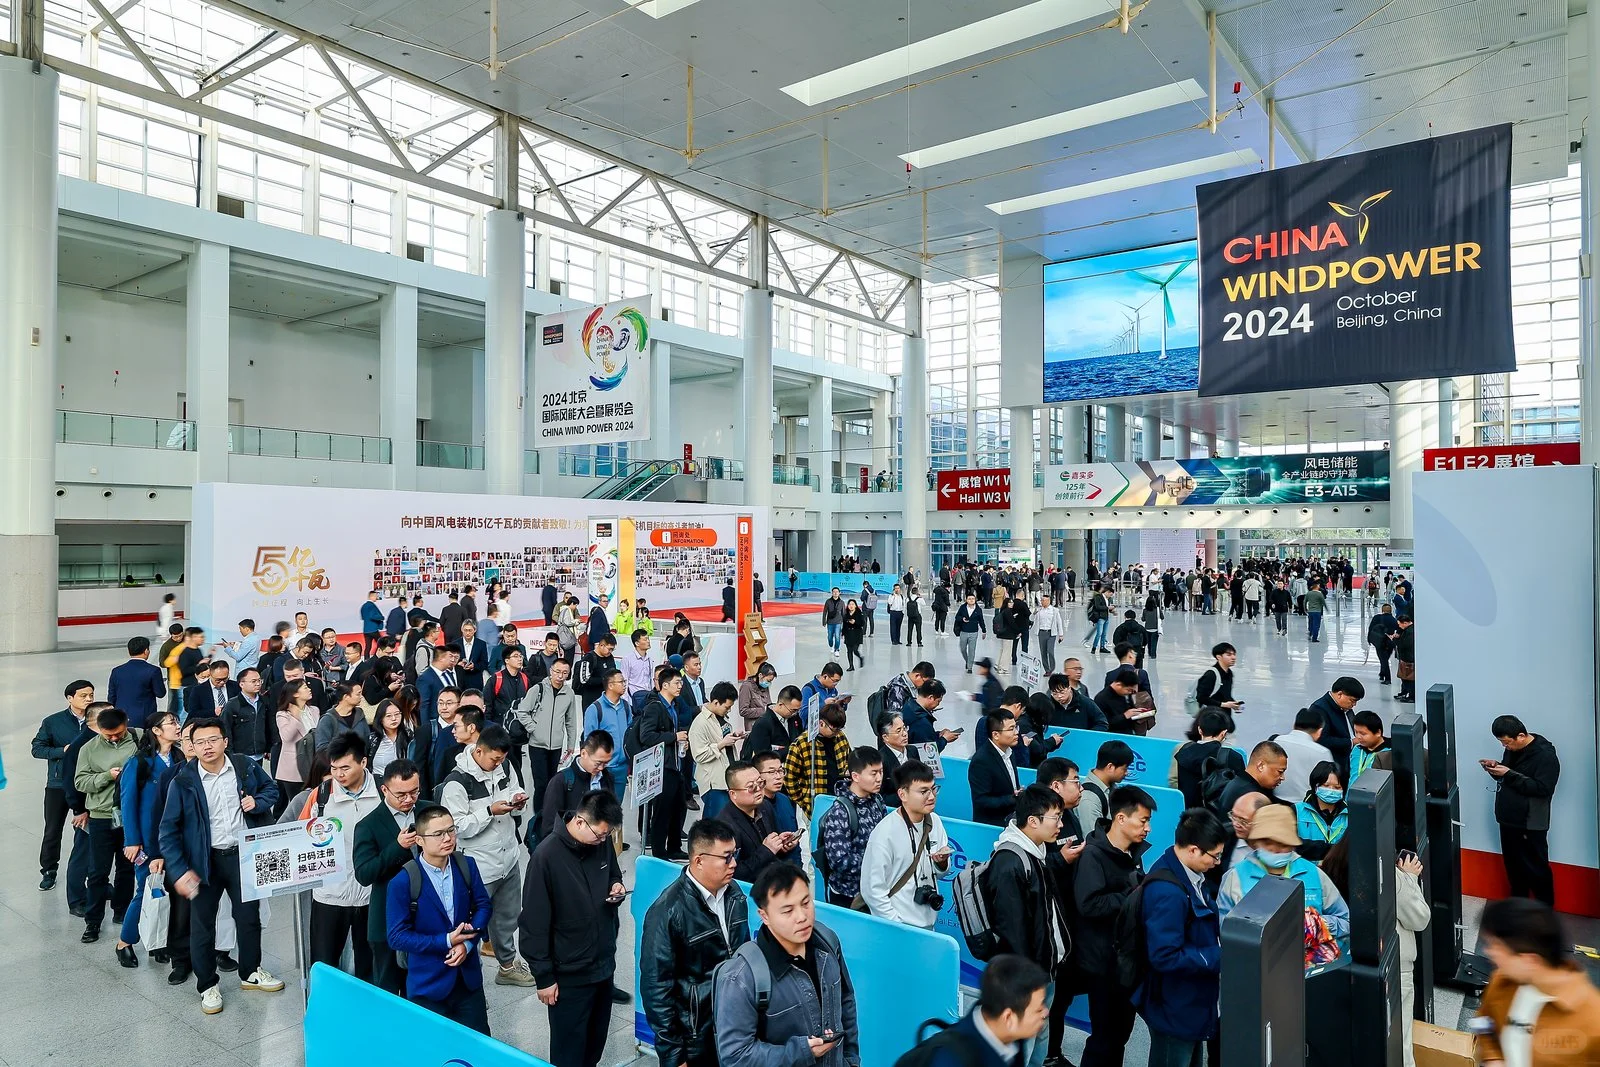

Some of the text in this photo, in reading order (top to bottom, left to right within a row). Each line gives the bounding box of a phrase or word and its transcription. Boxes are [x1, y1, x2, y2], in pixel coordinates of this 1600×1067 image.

[1223, 222, 1348, 264] CHINA
[1222, 242, 1482, 302] WINDPOWER
[1336, 289, 1417, 311] October
[1222, 303, 1315, 342] 2024
[1336, 305, 1442, 329] Beijing, China
[542, 401, 634, 423] 国际风能大会暨展览会
[542, 421, 634, 438] CHINA WIND POWER 2024
[1304, 456, 1358, 470] 风电储能
[1494, 453, 1535, 468] 展馆
[1071, 471, 1094, 480] 嘉实多
[1281, 468, 1358, 479] 全产业链的守护嘉
[958, 476, 981, 489] 展馆
[983, 474, 1000, 487] W1
[1065, 482, 1086, 491] 125年
[959, 493, 980, 504] Hall
[983, 491, 1001, 503] W3
[1054, 492, 1085, 501] 创领前行
[1304, 485, 1358, 497] E3-A15
[297, 848, 335, 863] 扫码注册
[298, 858, 336, 874] 换证入场
